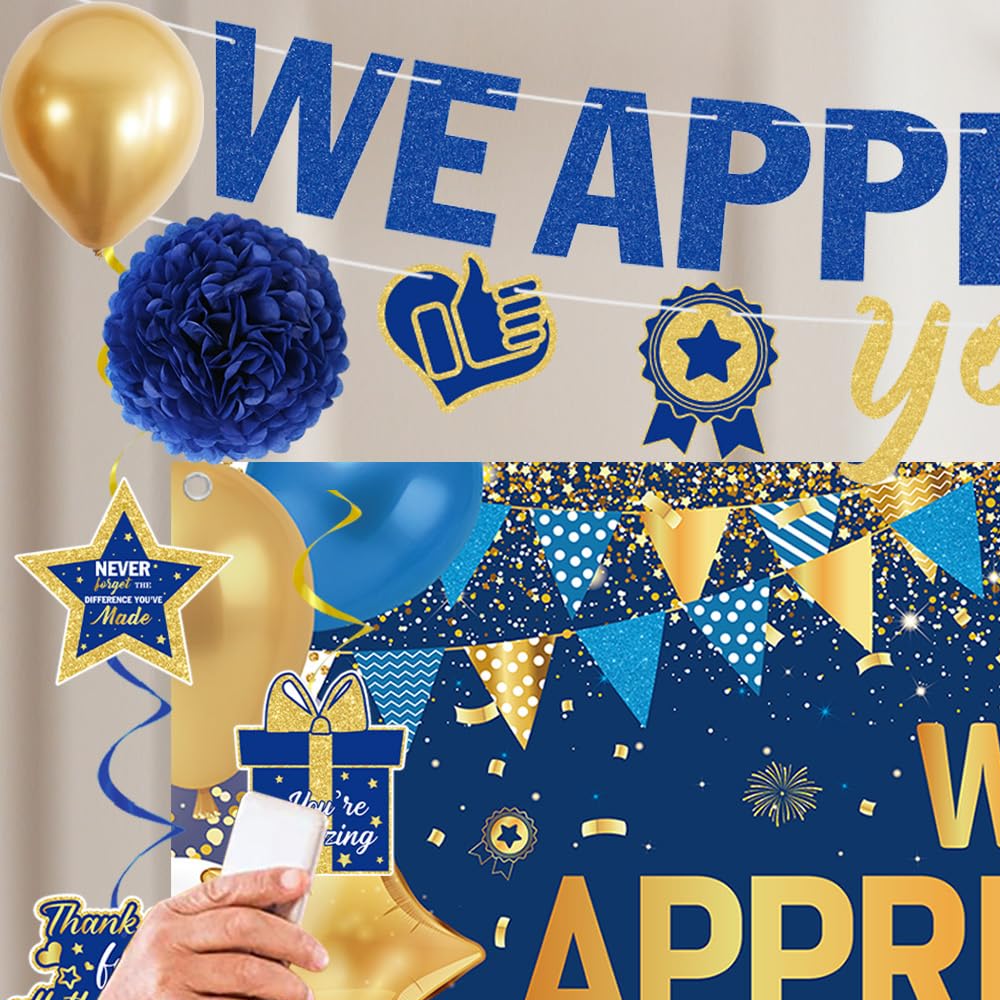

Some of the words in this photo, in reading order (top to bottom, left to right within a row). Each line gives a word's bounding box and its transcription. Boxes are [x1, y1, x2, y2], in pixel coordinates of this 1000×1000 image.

[215, 20, 521, 248] WE
[95, 561, 151, 576] NEVER
[93, 577, 132, 595] forget
[135, 581, 152, 589] THE
[84, 595, 133, 604] DIFFERENCE
[134, 595, 163, 604] YOU'VE
[89, 605, 153, 626] Made
[324, 824, 378, 855] zing
[42, 902, 138, 936] Thank
